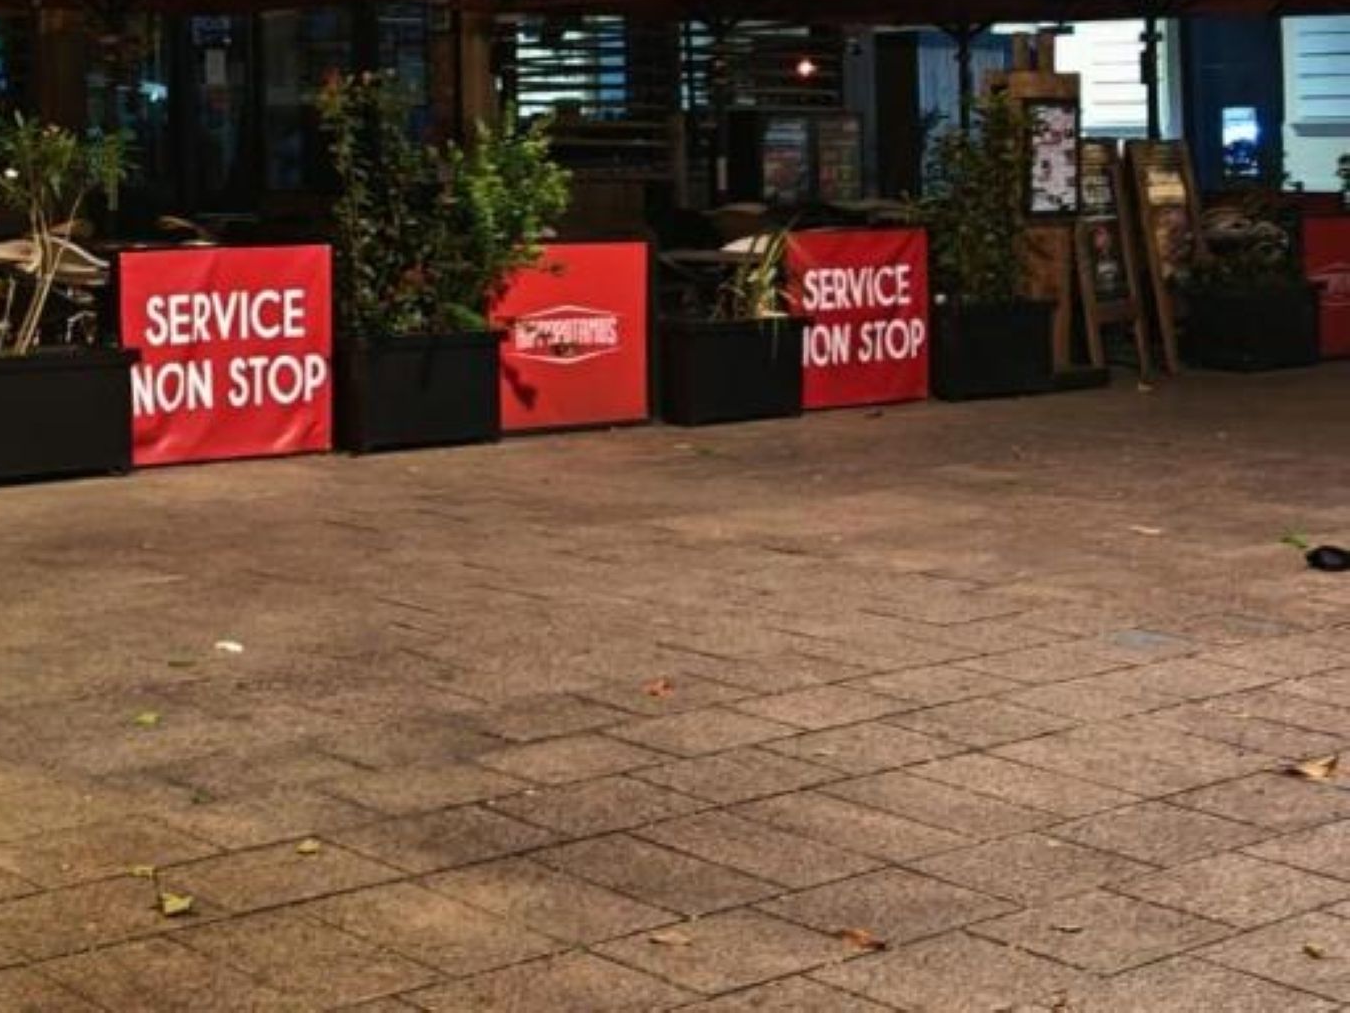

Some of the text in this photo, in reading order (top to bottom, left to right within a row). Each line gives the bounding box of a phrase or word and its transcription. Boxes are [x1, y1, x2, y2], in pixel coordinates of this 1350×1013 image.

[802, 264, 912, 311] SERVICE
[144, 288, 307, 346] SERVICE
[858, 317, 926, 363] STOP
[130, 352, 328, 417] NON STOP
